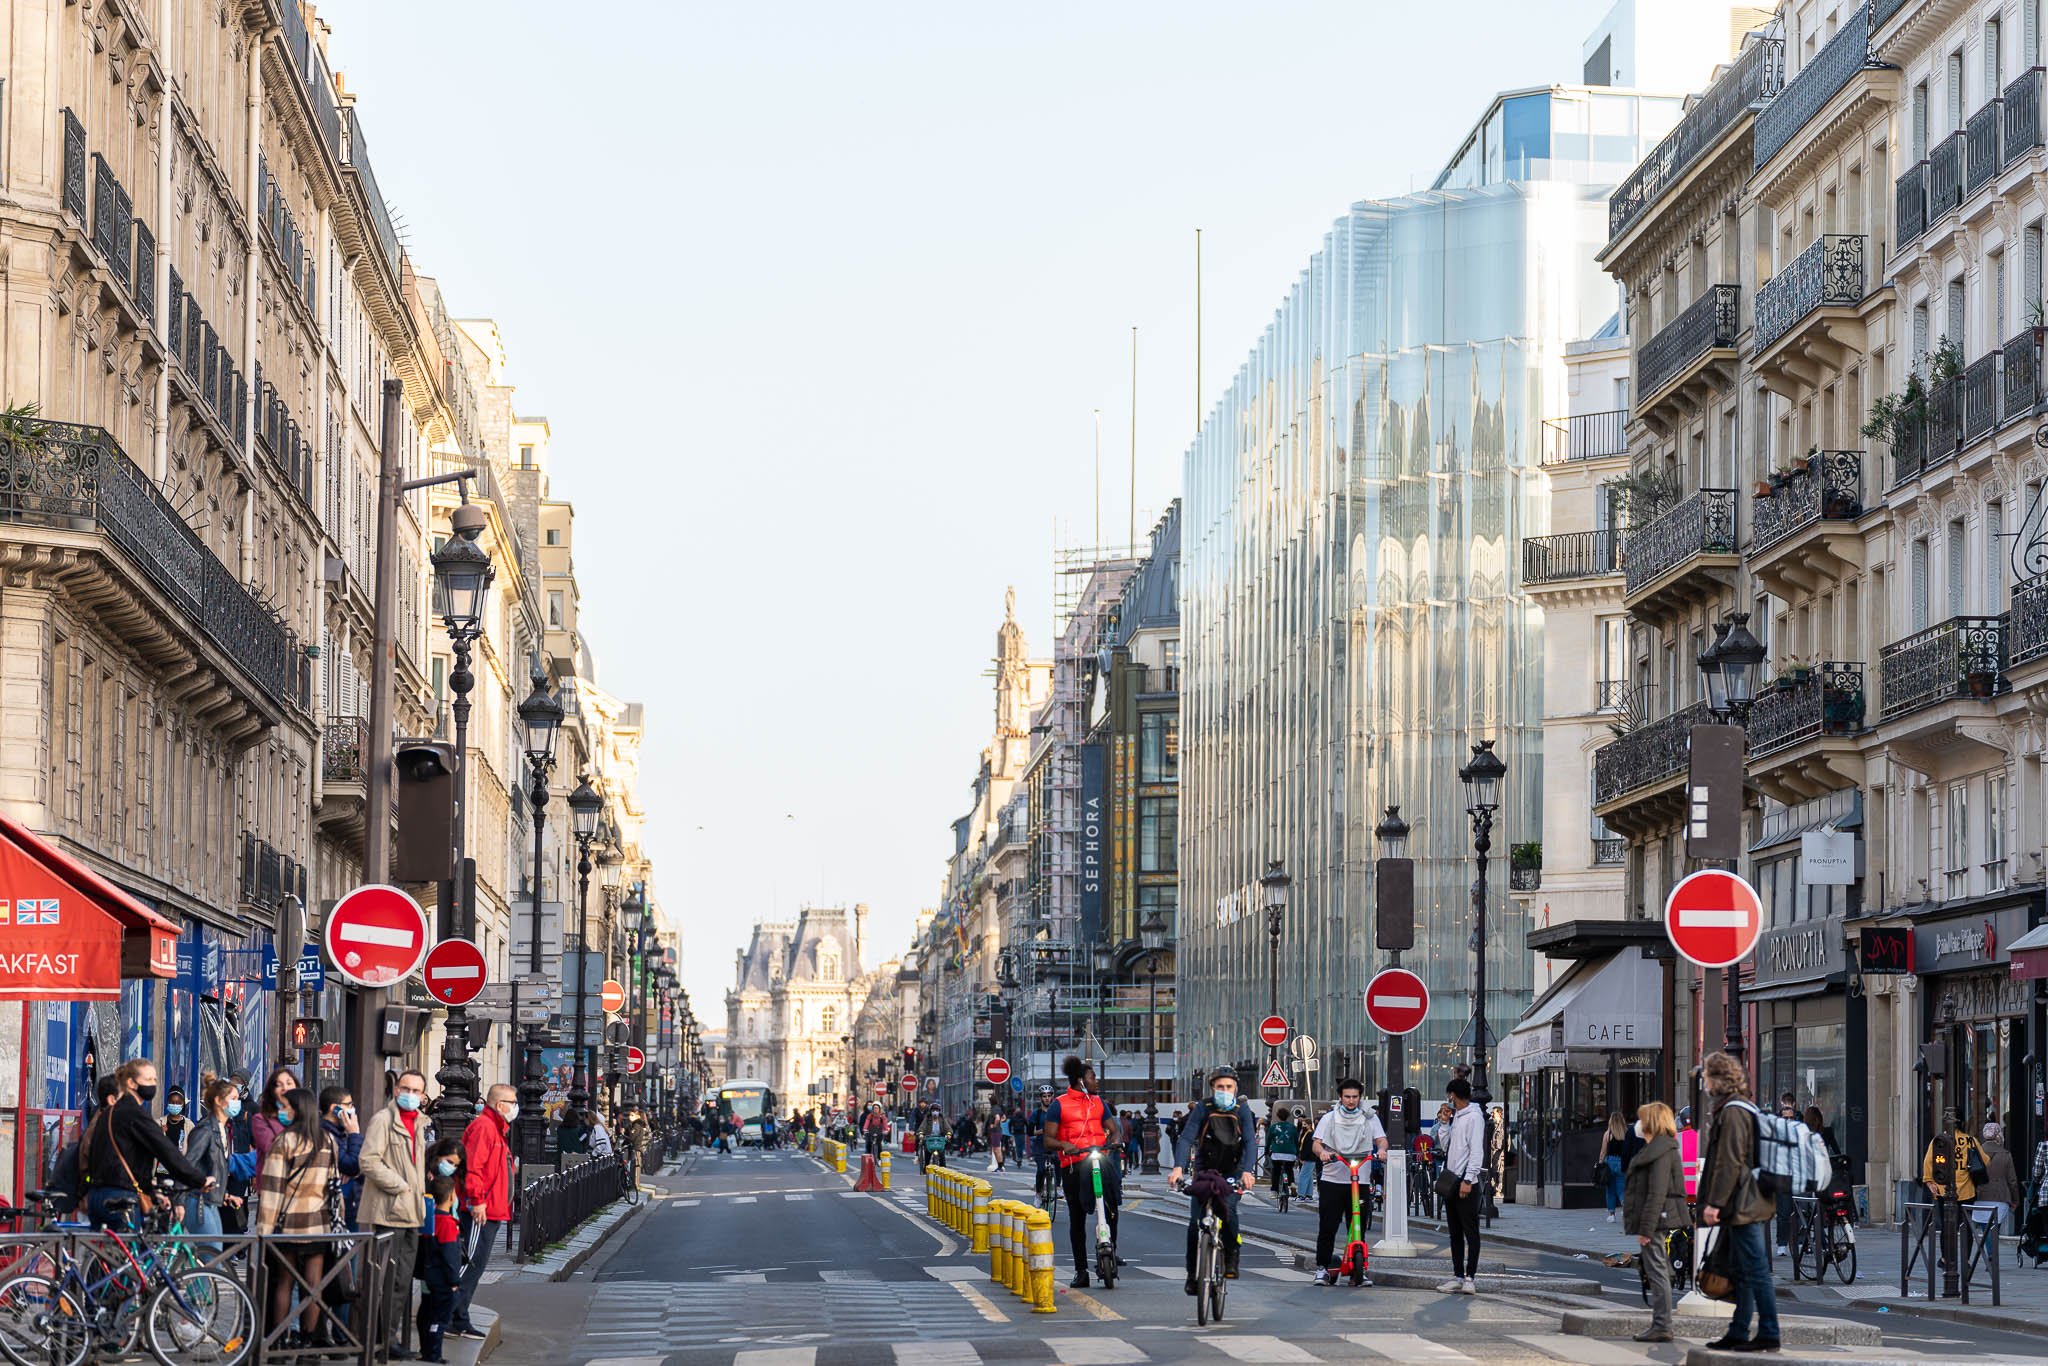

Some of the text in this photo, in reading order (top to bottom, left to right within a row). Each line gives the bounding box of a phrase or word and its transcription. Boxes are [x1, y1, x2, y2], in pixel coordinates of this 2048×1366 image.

[1085, 797, 1099, 892] SEPHORA
[1770, 929, 1826, 973] PRONUPTIA
[1588, 1024, 1635, 1041] CAFE
